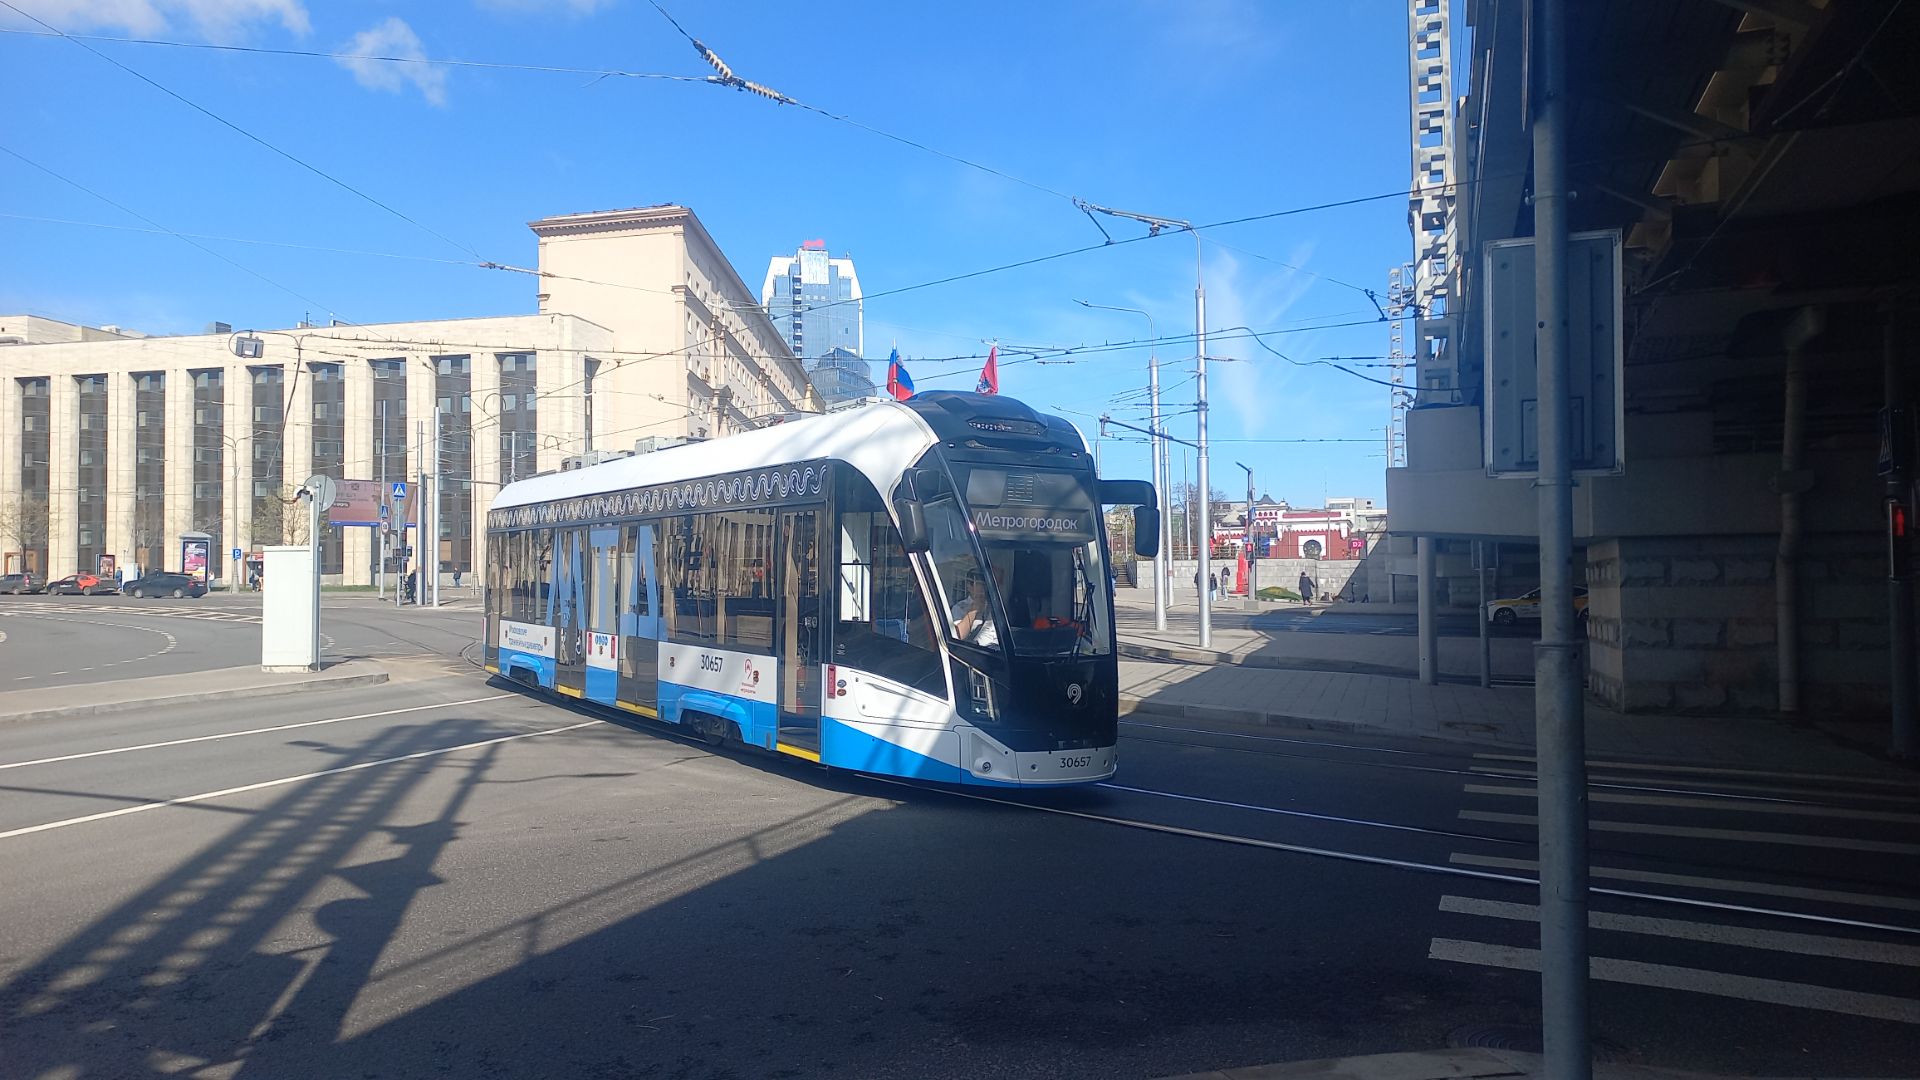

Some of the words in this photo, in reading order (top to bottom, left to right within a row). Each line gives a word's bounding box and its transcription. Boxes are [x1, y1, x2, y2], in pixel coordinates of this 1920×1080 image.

[976, 511, 1078, 531] Метрогородок
[700, 654, 723, 673] 30657
[1060, 756, 1092, 768] 30657
